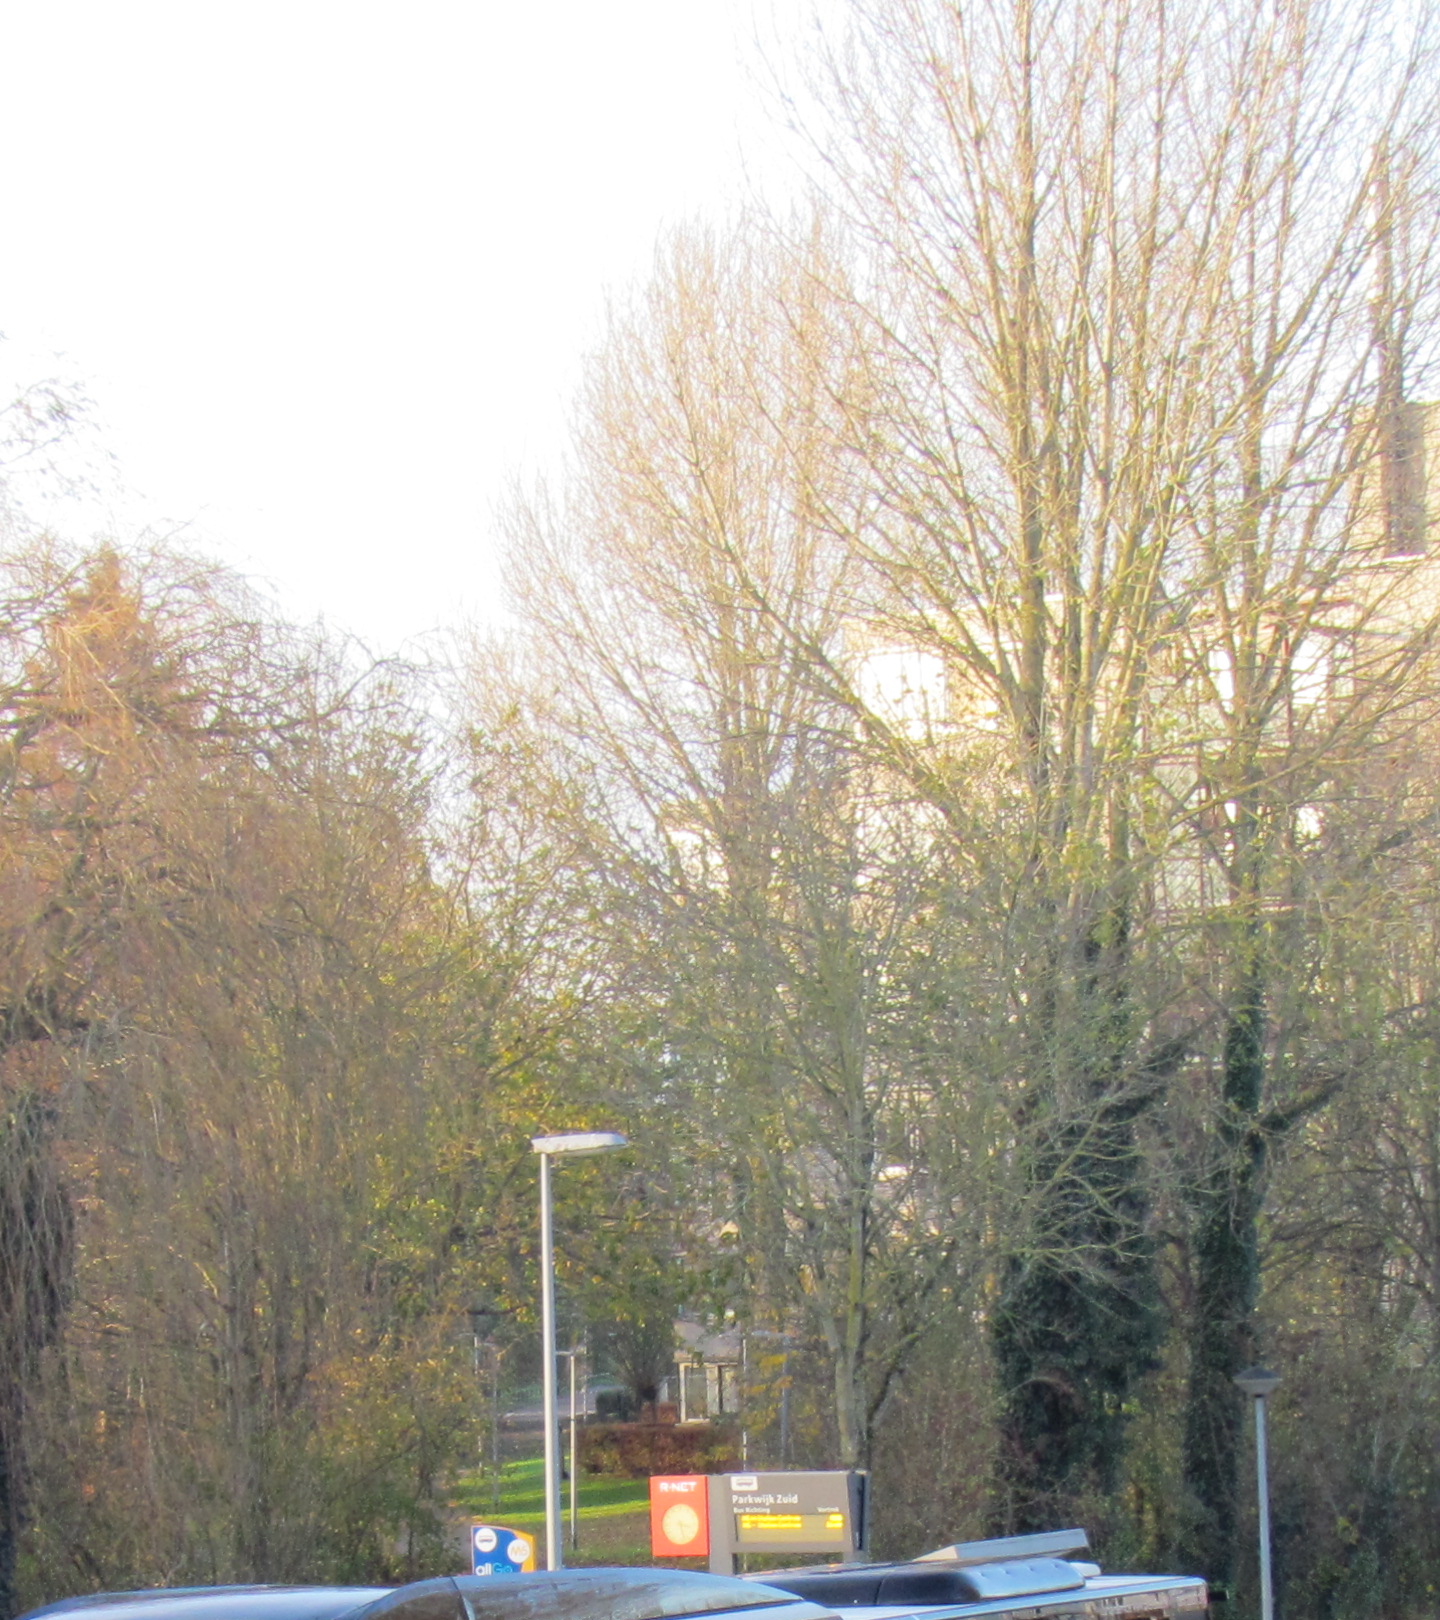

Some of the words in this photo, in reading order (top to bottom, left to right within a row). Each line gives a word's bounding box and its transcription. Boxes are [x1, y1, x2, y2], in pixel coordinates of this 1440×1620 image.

[732, 1494, 775, 1506] Parkwijk
[777, 1494, 799, 1504] Zuid
[475, 1562, 514, 1577] allGo
